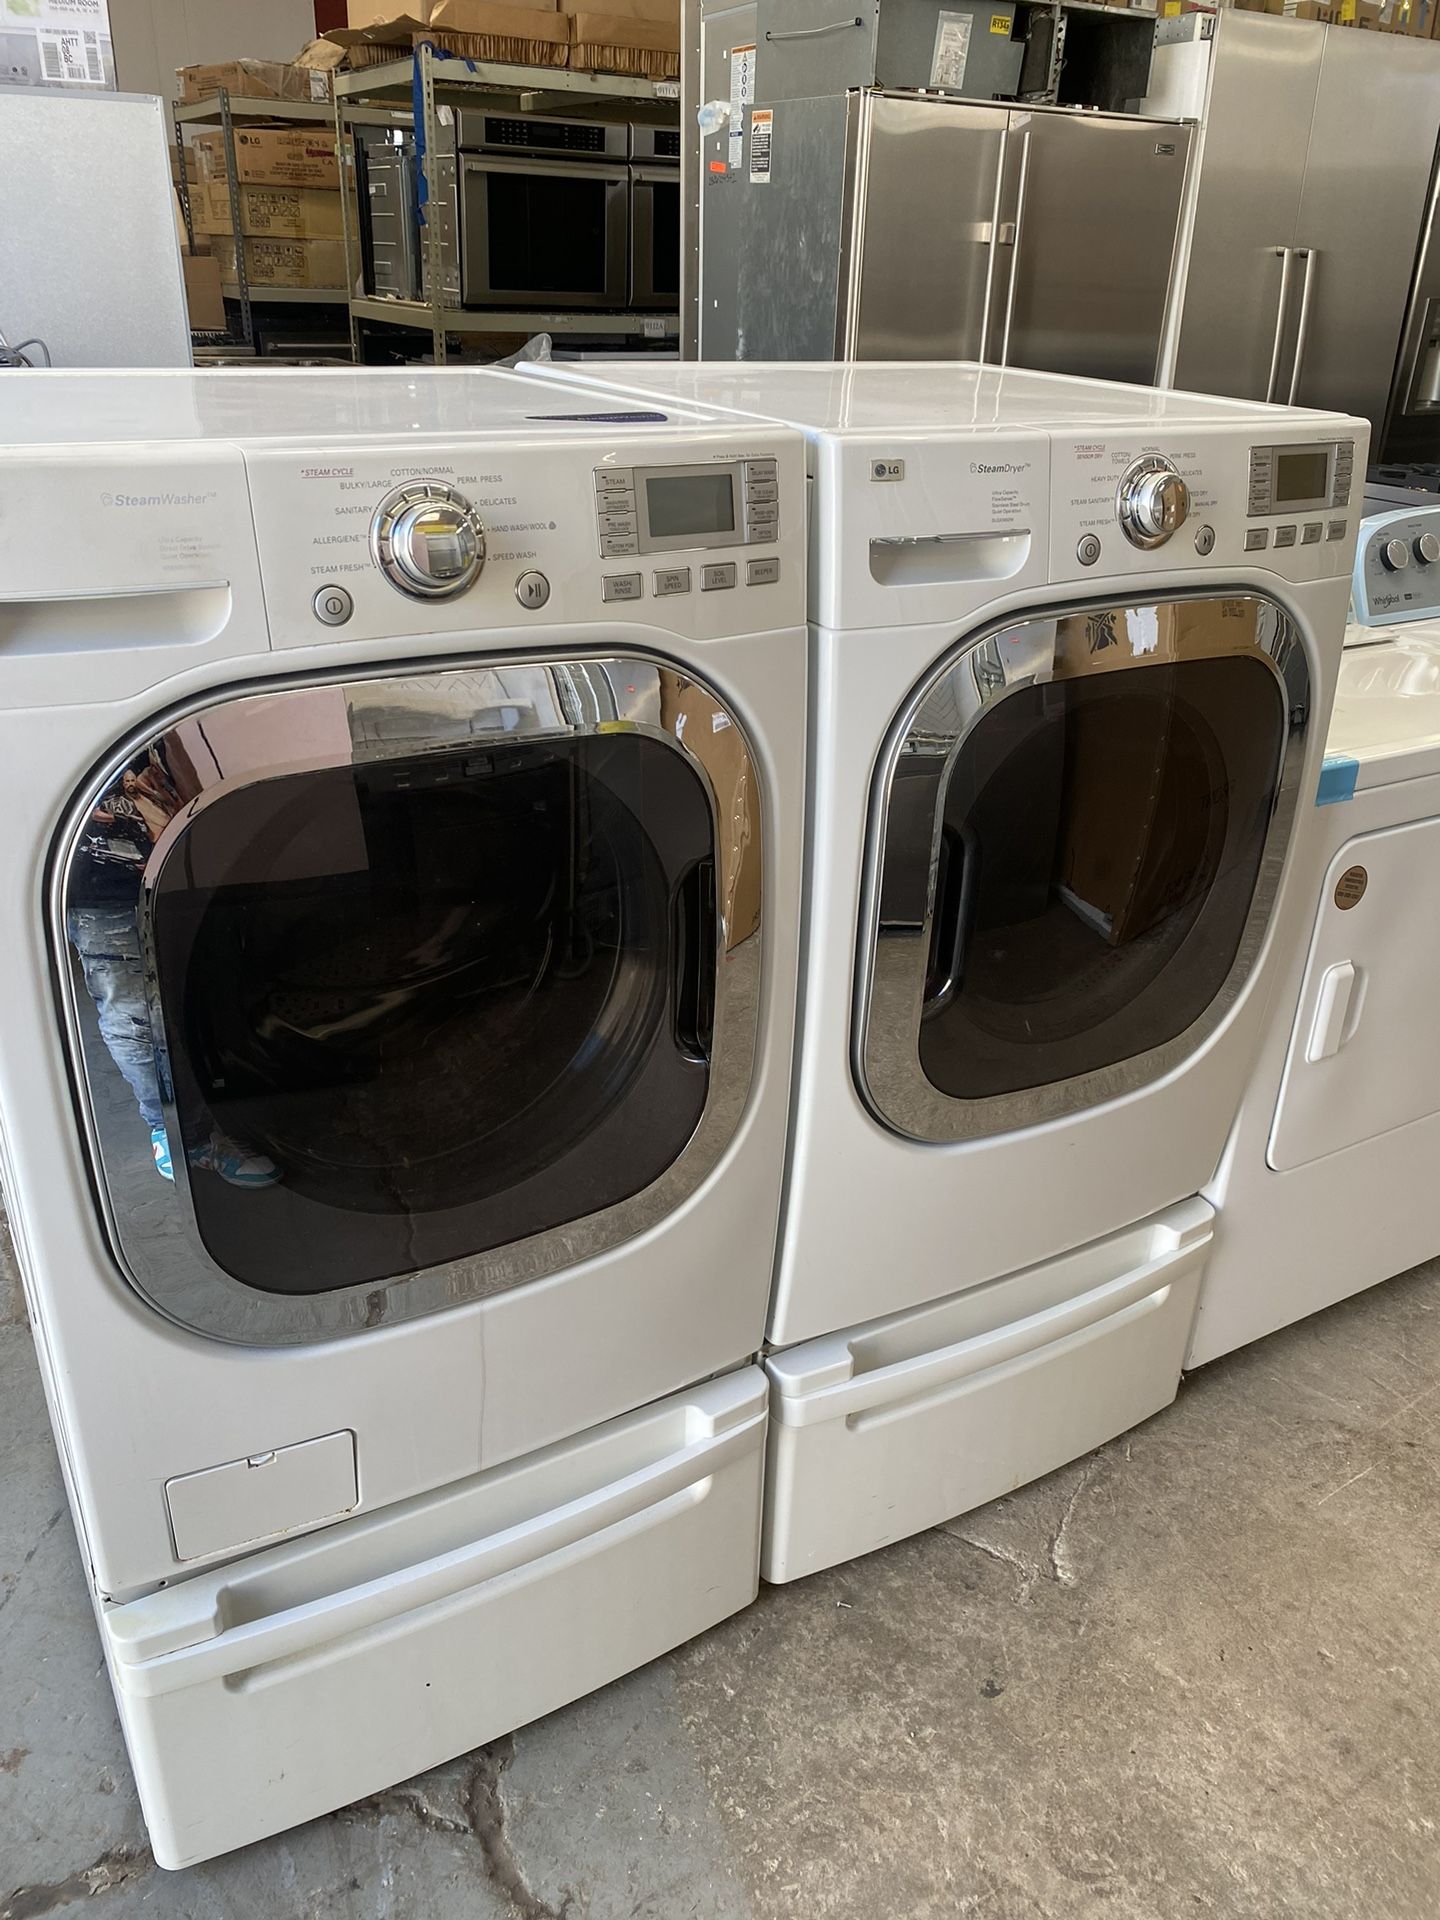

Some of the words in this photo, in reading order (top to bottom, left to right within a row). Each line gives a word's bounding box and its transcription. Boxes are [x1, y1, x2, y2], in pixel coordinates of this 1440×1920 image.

[249, 136, 261, 145] LG
[332, 468, 354, 476] CYCLE
[888, 466, 900, 474] LG
[480, 475, 503, 483] PRESS
[339, 480, 393, 490] BULKY/LARGE
[479, 497, 518, 507] DELICATES
[335, 506, 373, 515] SANITARY
[491, 524, 509, 533] HAND
[492, 553, 515, 561] SPEED
[516, 551, 537, 559] WASH
[310, 566, 339, 575] STEAM
[713, 569, 725, 577] SOIL
[754, 567, 773, 576] BEEPER
[613, 580, 632, 588] WASH
[711, 576, 727, 584] LEVEL
[614, 587, 632, 595] RINSE
[1373, 594, 1400, 608] Whirlpool
